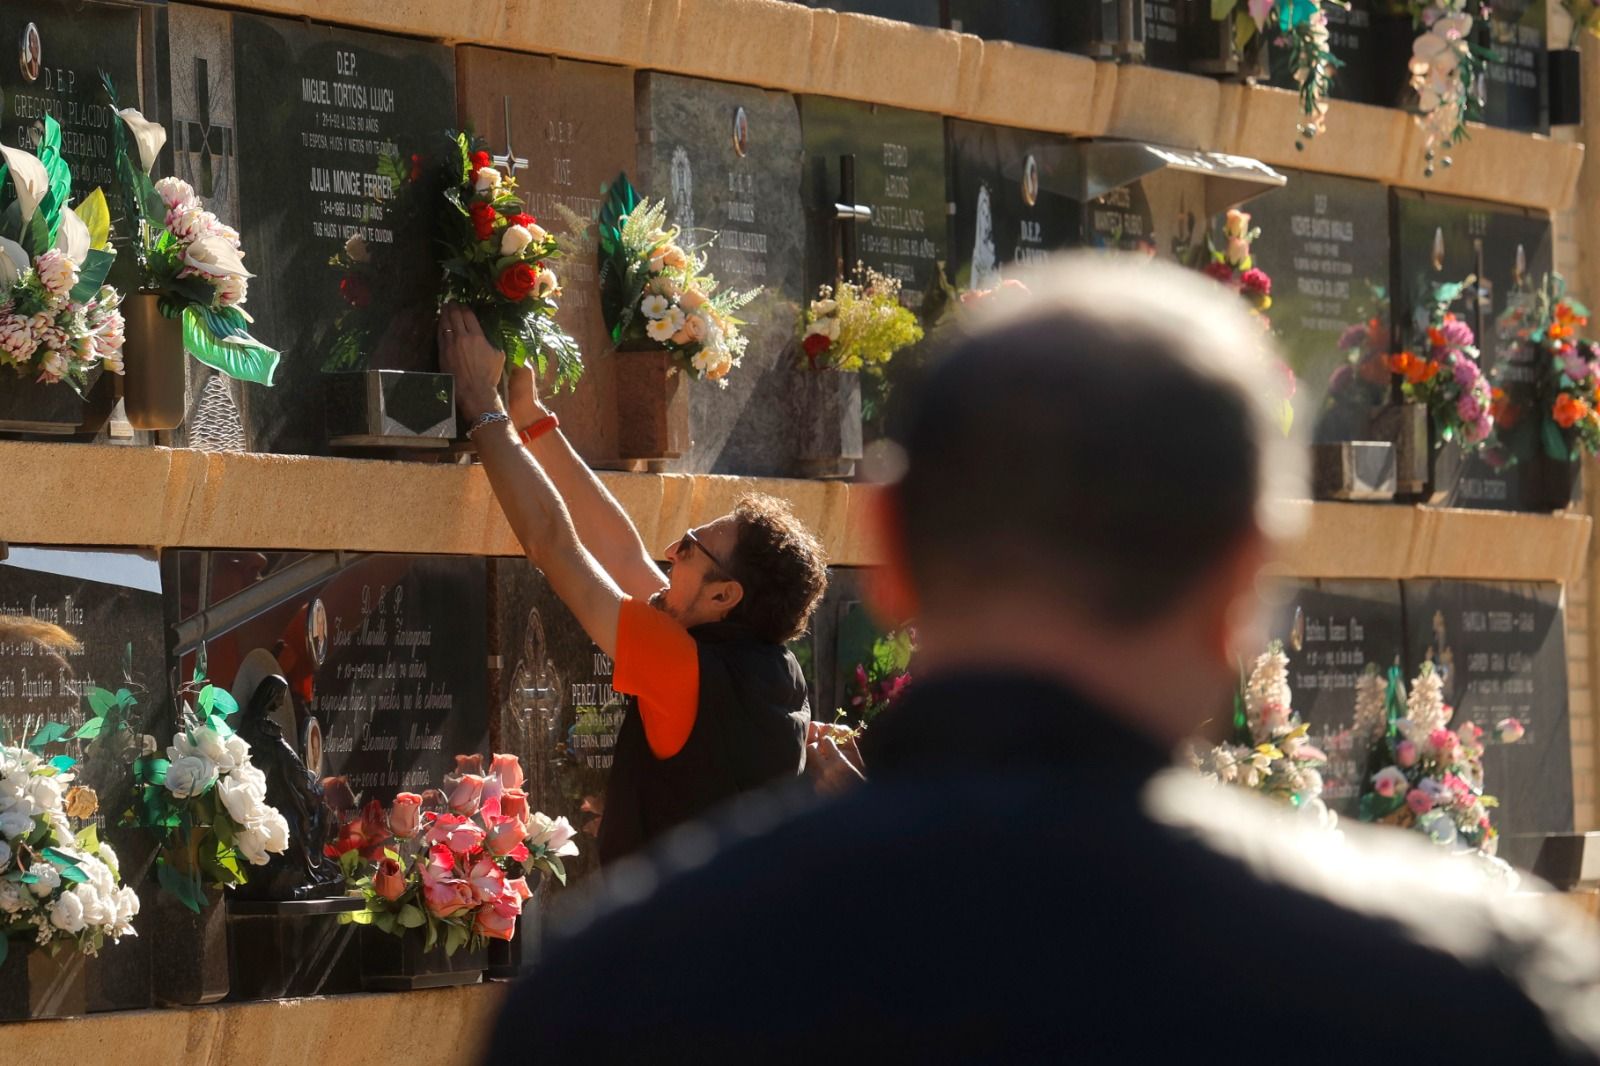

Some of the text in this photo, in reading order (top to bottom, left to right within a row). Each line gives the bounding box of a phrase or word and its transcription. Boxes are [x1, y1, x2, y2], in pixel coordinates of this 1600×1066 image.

[302, 78, 394, 113] MIGUEL TORTOSA LLUCH
[67, 101, 109, 128] PLACIDO
[62, 130, 108, 158] SERRANO
[310, 167, 331, 193] JULIA
[333, 170, 361, 196] MONGE
[351, 204, 362, 219] LOS
[871, 204, 925, 232] CASTELLANOS
[313, 221, 323, 237] TUS
[367, 227, 375, 242] TE
[593, 653, 612, 676] JOSE
[572, 683, 596, 706] PEREZ
